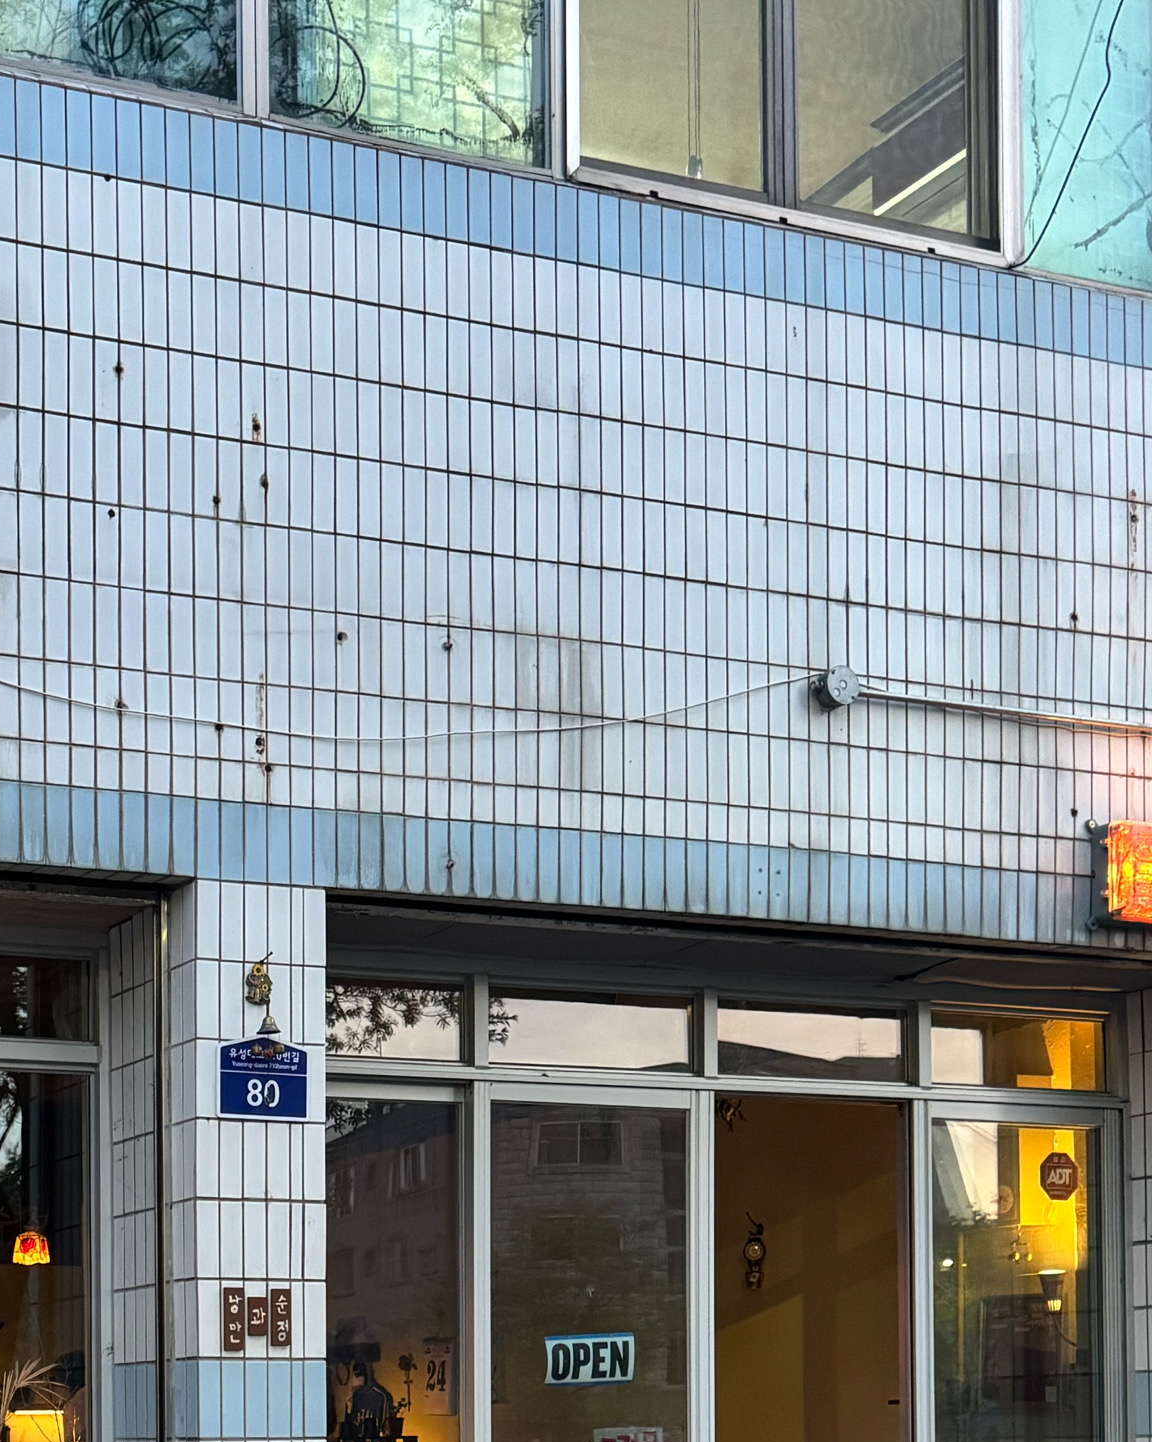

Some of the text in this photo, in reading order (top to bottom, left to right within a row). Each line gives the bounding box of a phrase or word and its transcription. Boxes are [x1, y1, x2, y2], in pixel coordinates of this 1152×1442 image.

[246, 1078, 280, 1108] 80
[1047, 1168, 1073, 1185] ADT
[228, 1294, 289, 1344] 낭만 과 순정
[425, 1359, 446, 1392] 24
[550, 1340, 630, 1381] OPEN
